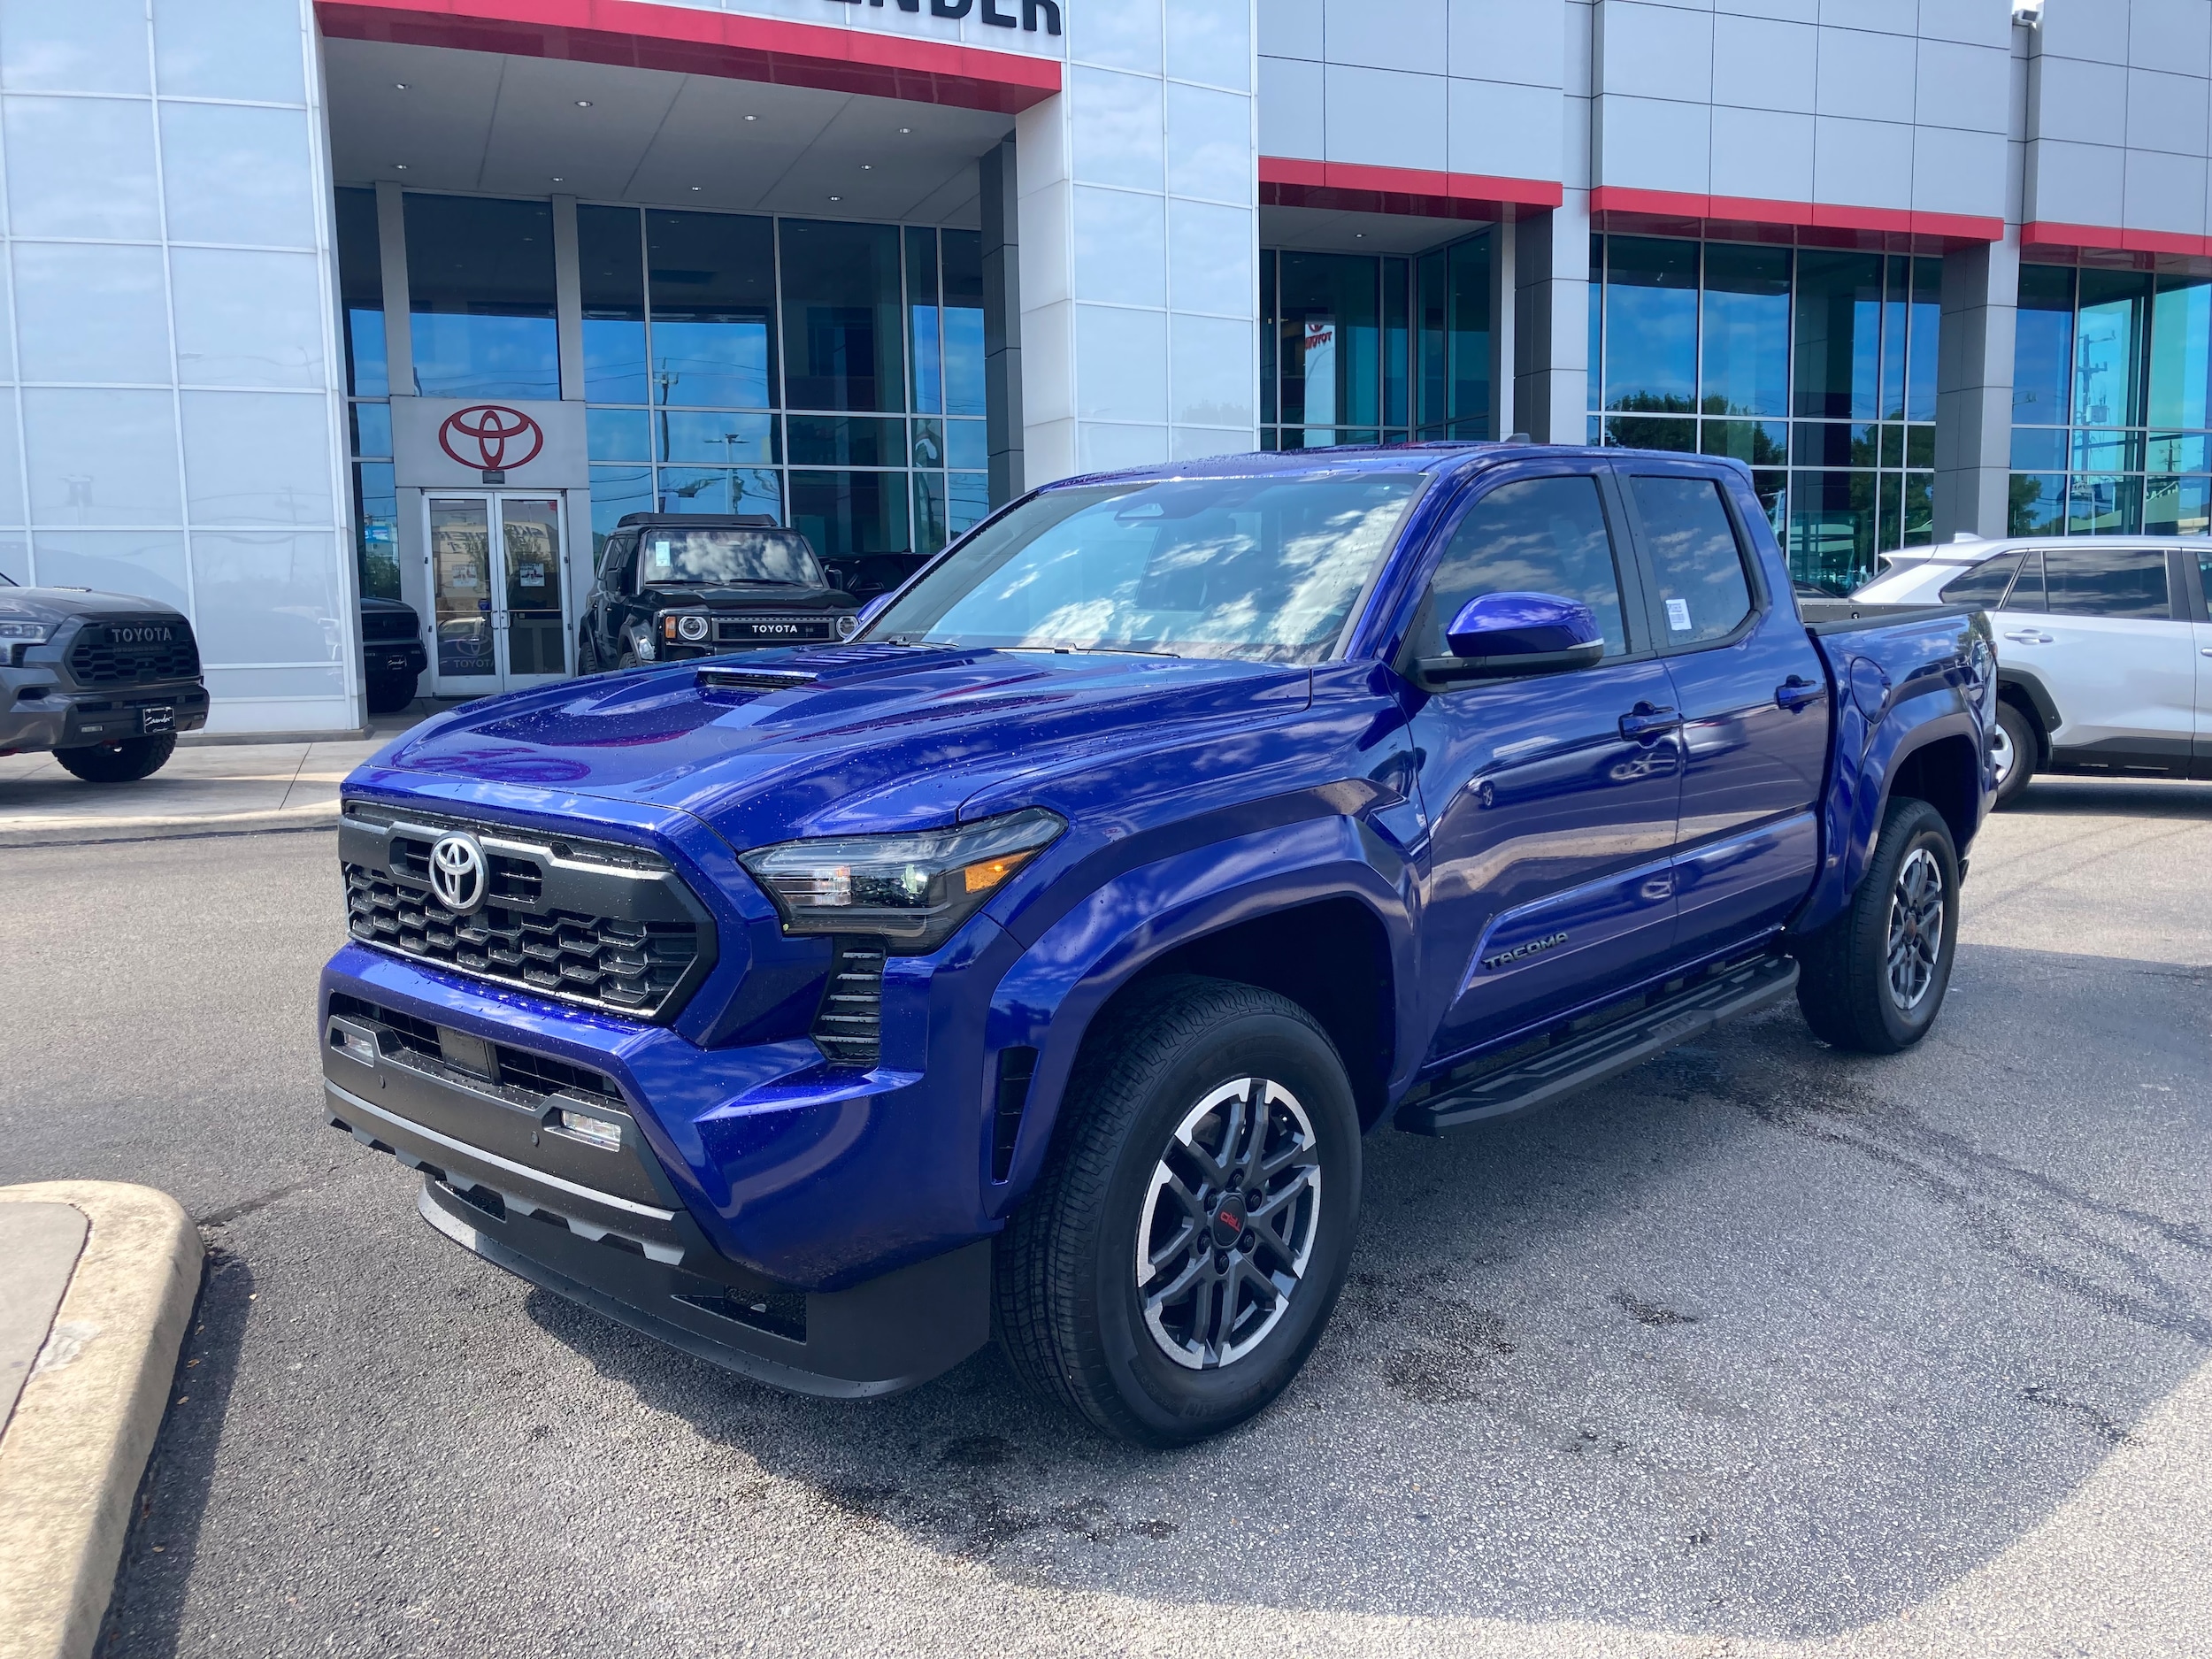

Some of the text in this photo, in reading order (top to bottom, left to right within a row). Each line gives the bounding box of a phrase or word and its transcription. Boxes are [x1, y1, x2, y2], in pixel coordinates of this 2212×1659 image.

[111, 626, 173, 643] TOYOTA
[751, 625, 798, 634] TOYOTA
[1481, 932, 1569, 971] TACOMA
